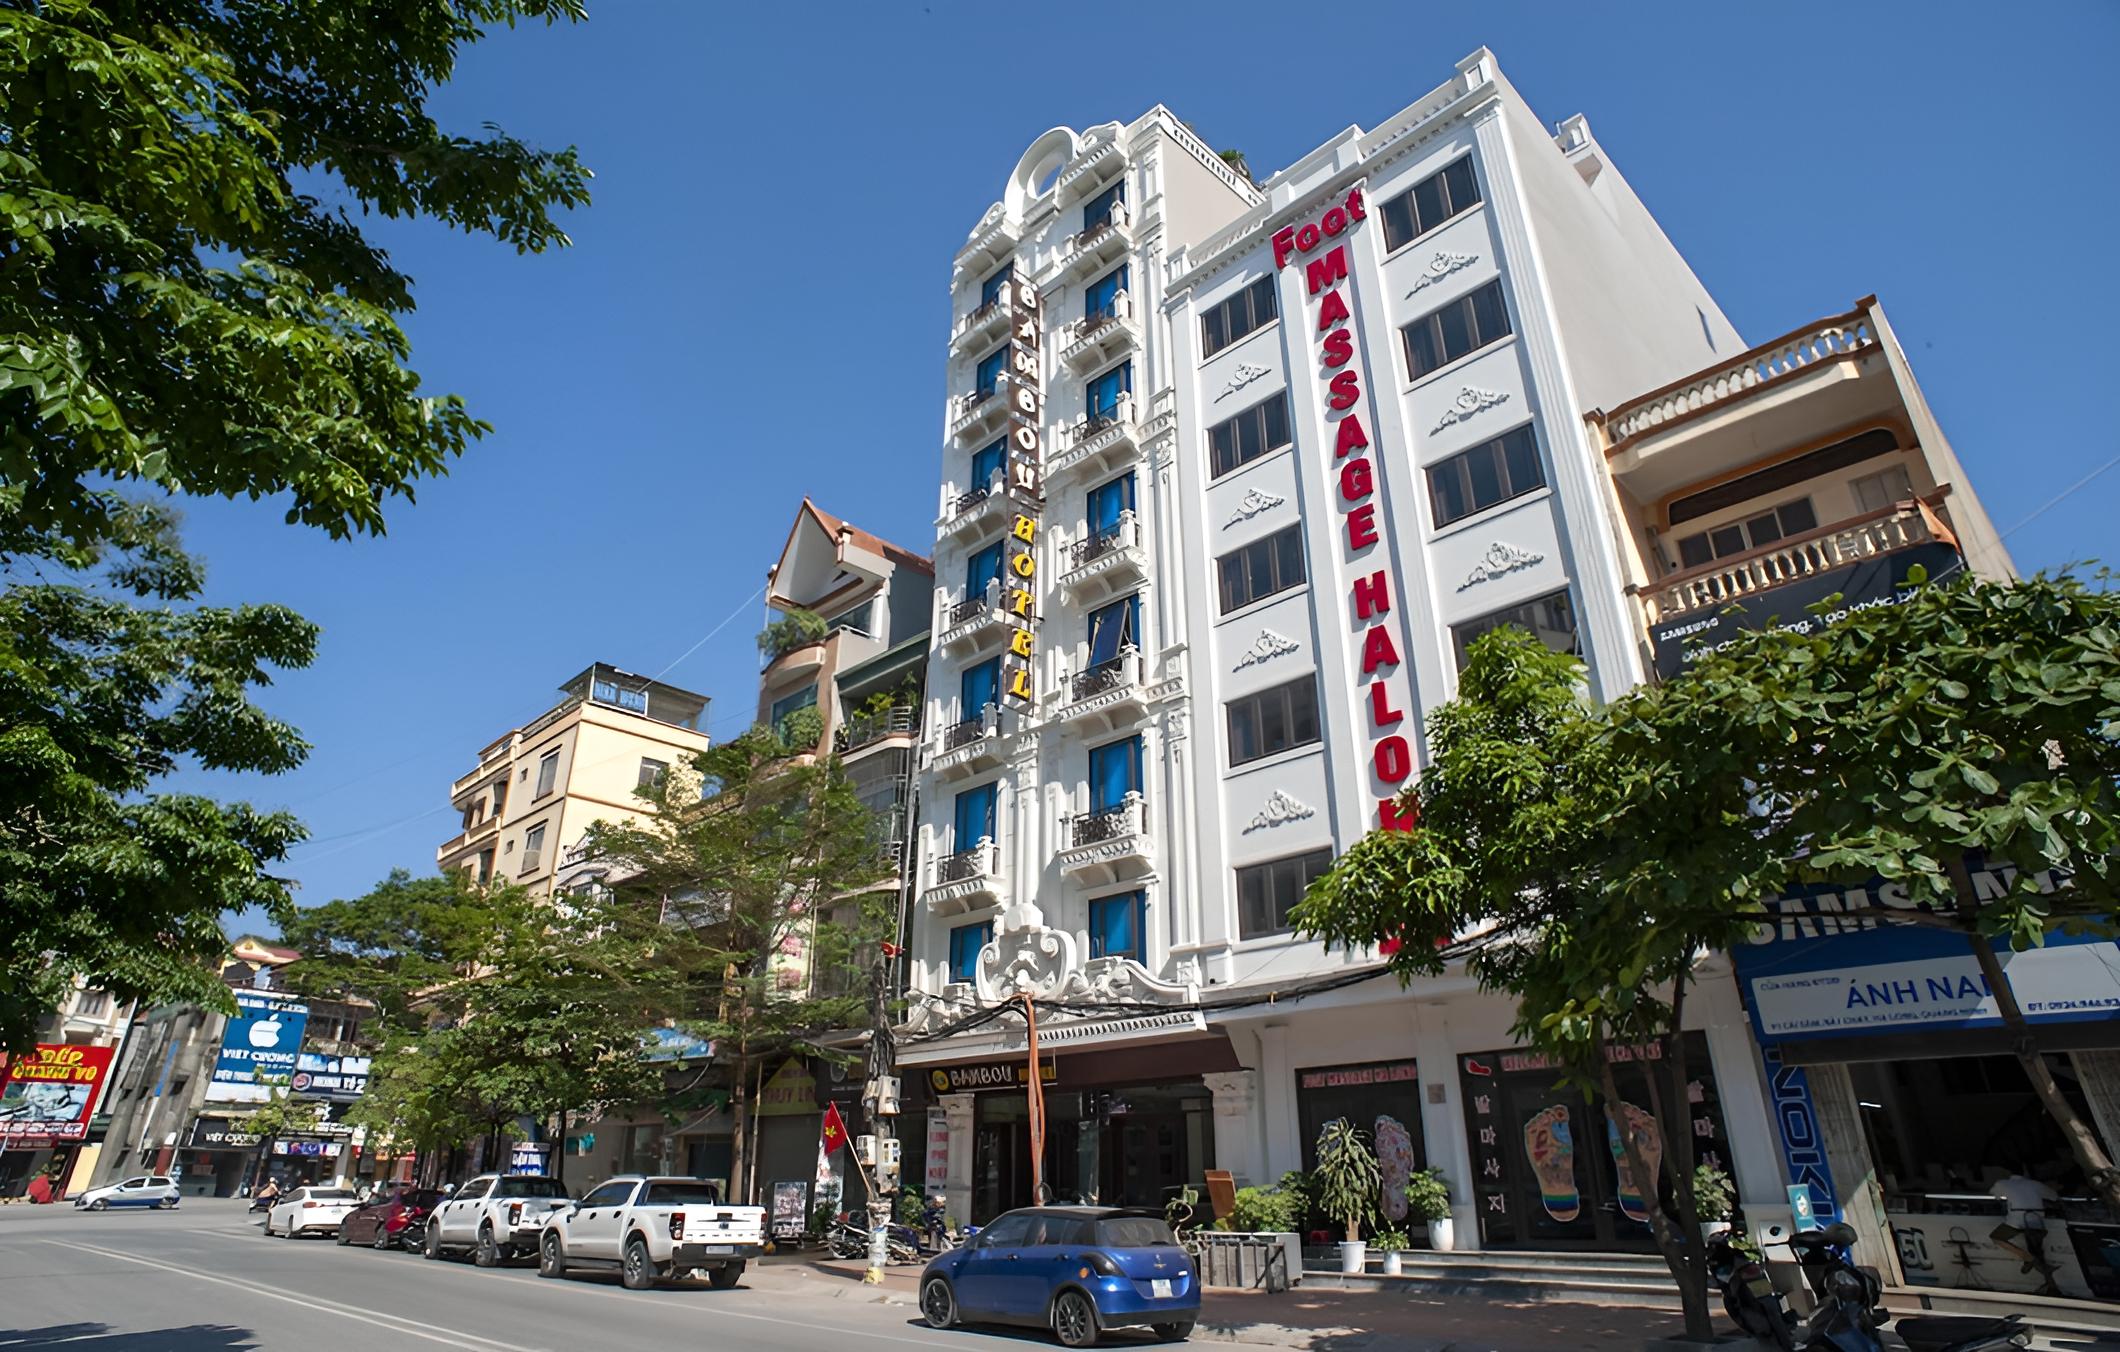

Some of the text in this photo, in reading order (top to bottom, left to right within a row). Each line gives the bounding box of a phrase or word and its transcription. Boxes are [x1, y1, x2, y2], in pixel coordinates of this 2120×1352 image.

[1271, 184, 1367, 271] Foot
[1306, 245, 1379, 551] MASSAGE
[1008, 284, 1038, 701] BAMBOU HOTEL
[1846, 979, 1919, 1009] ÁNH
[950, 1064, 1013, 1088] BAMBOU
